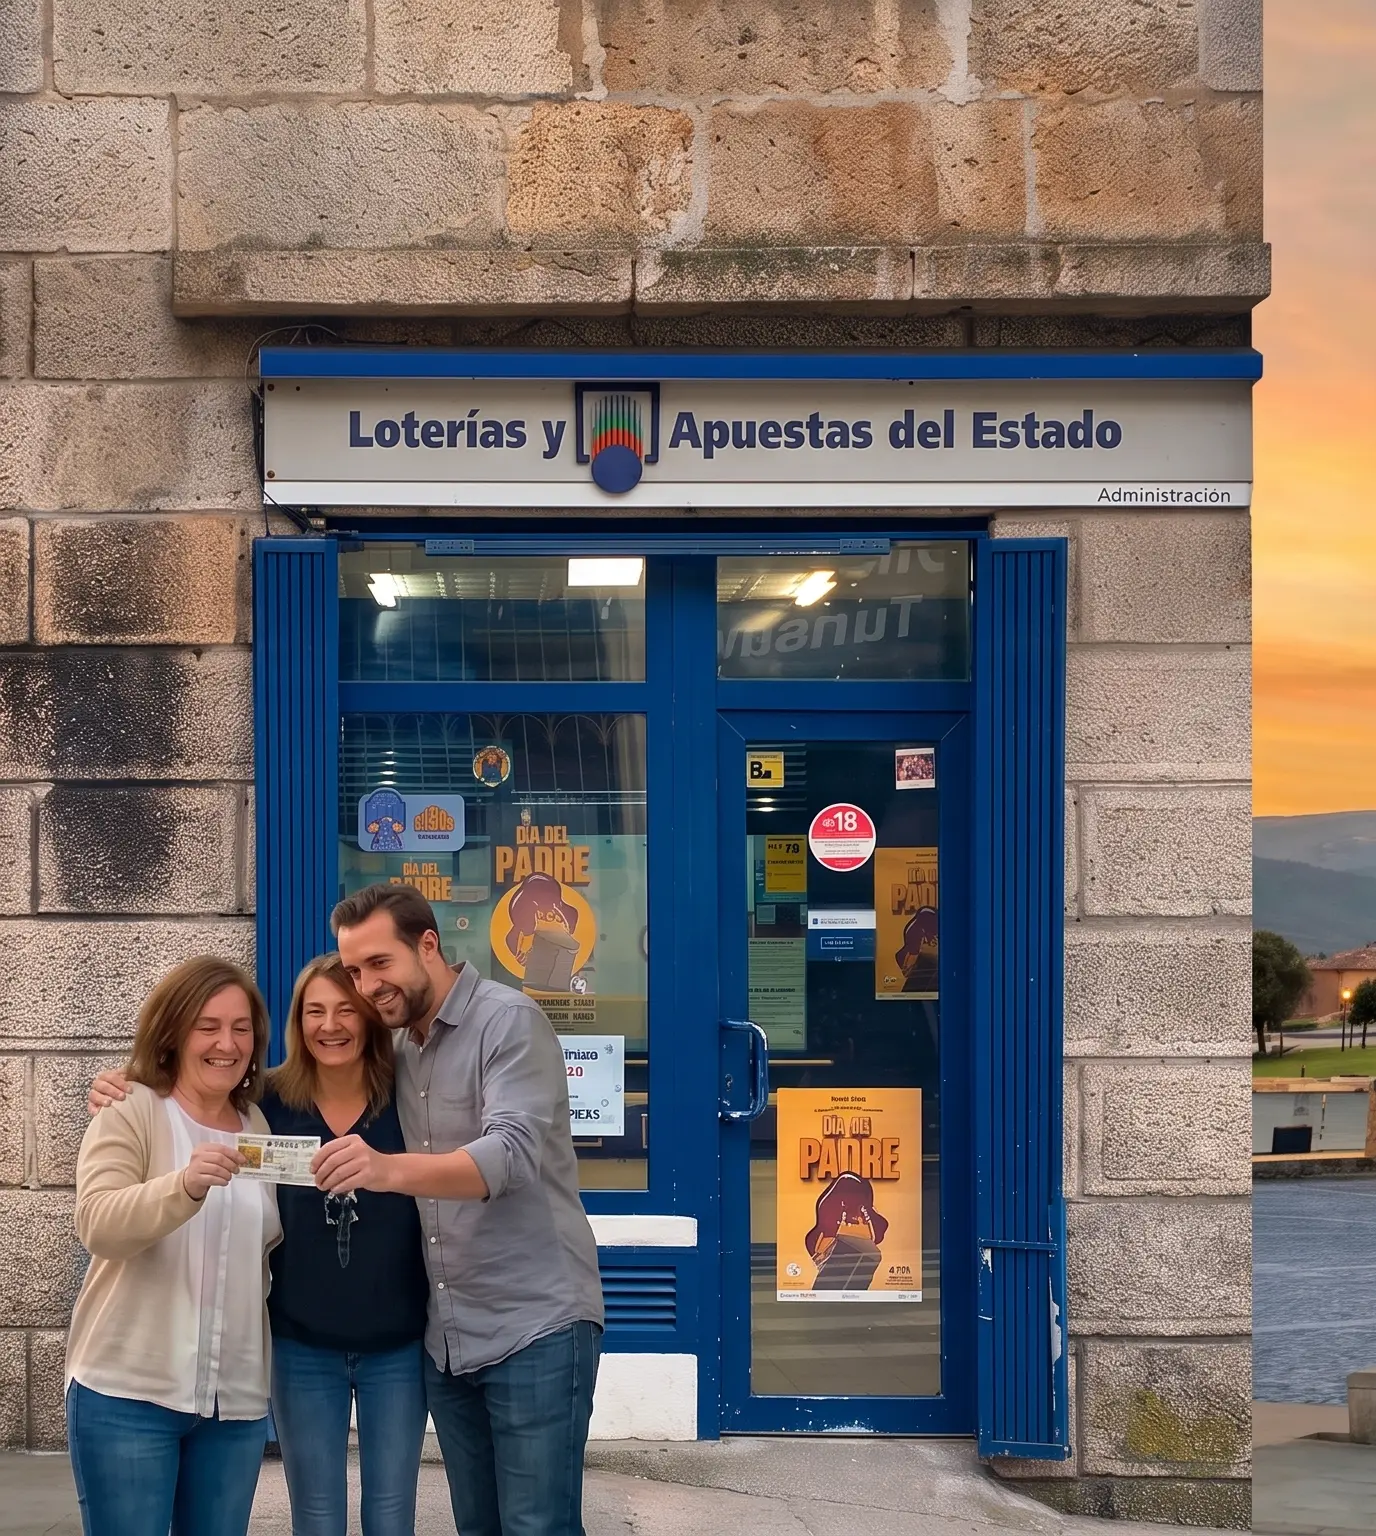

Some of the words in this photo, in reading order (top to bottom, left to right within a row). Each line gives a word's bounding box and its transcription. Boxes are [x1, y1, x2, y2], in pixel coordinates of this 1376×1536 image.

[348, 408, 527, 449] Loterías
[542, 420, 566, 459] y
[668, 411, 873, 460] Apuestas
[888, 409, 955, 449] del
[972, 409, 1122, 449] Estado
[1097, 487, 1231, 504] Administración
[833, 811, 858, 832] 18
[544, 825, 570, 844] DEL
[496, 846, 590, 884] PADRE
